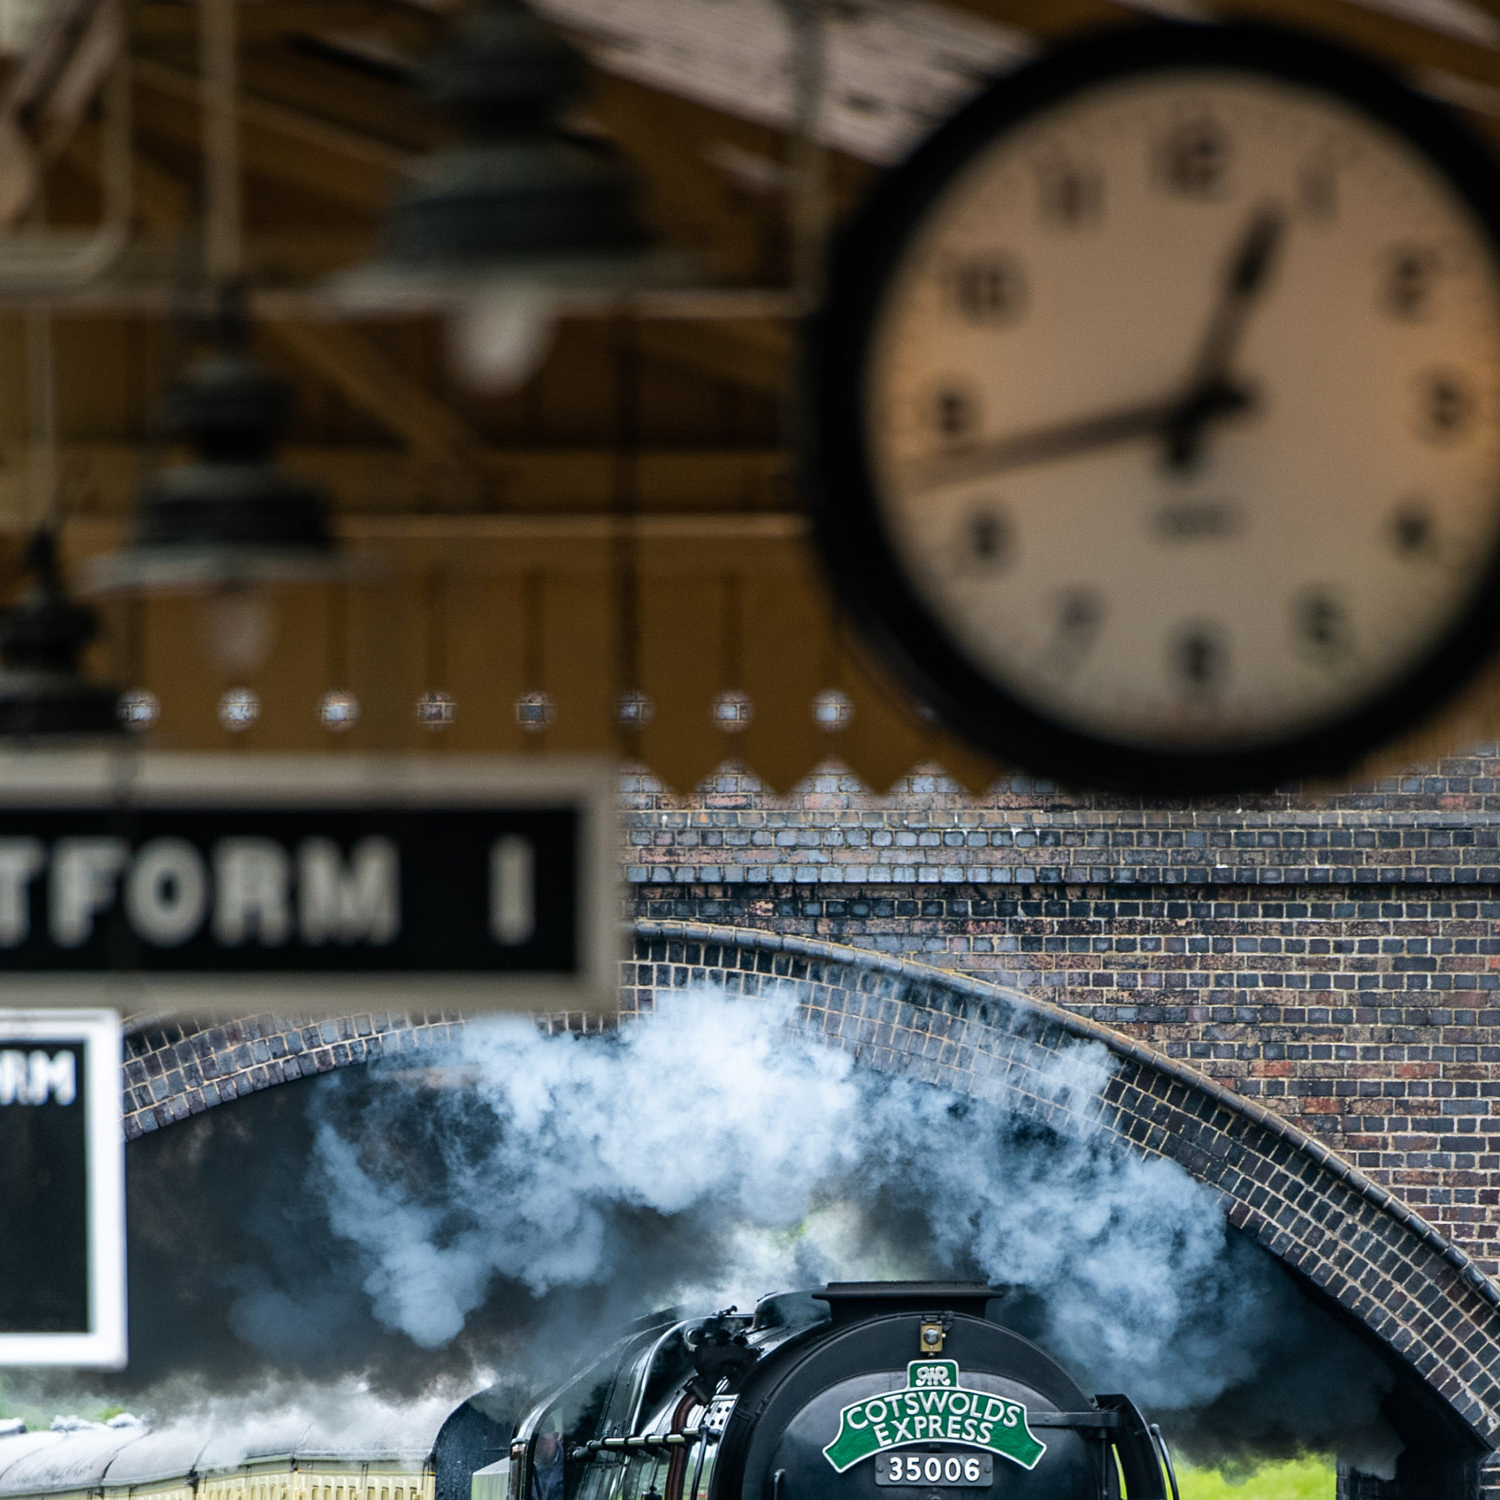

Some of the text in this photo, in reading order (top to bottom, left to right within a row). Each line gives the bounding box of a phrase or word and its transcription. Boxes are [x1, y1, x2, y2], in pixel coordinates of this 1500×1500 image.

[847, 1392, 1021, 1429] COTSWOLDS
[873, 1416, 993, 1447] EXPRESS
[889, 1457, 980, 1482] 35006
